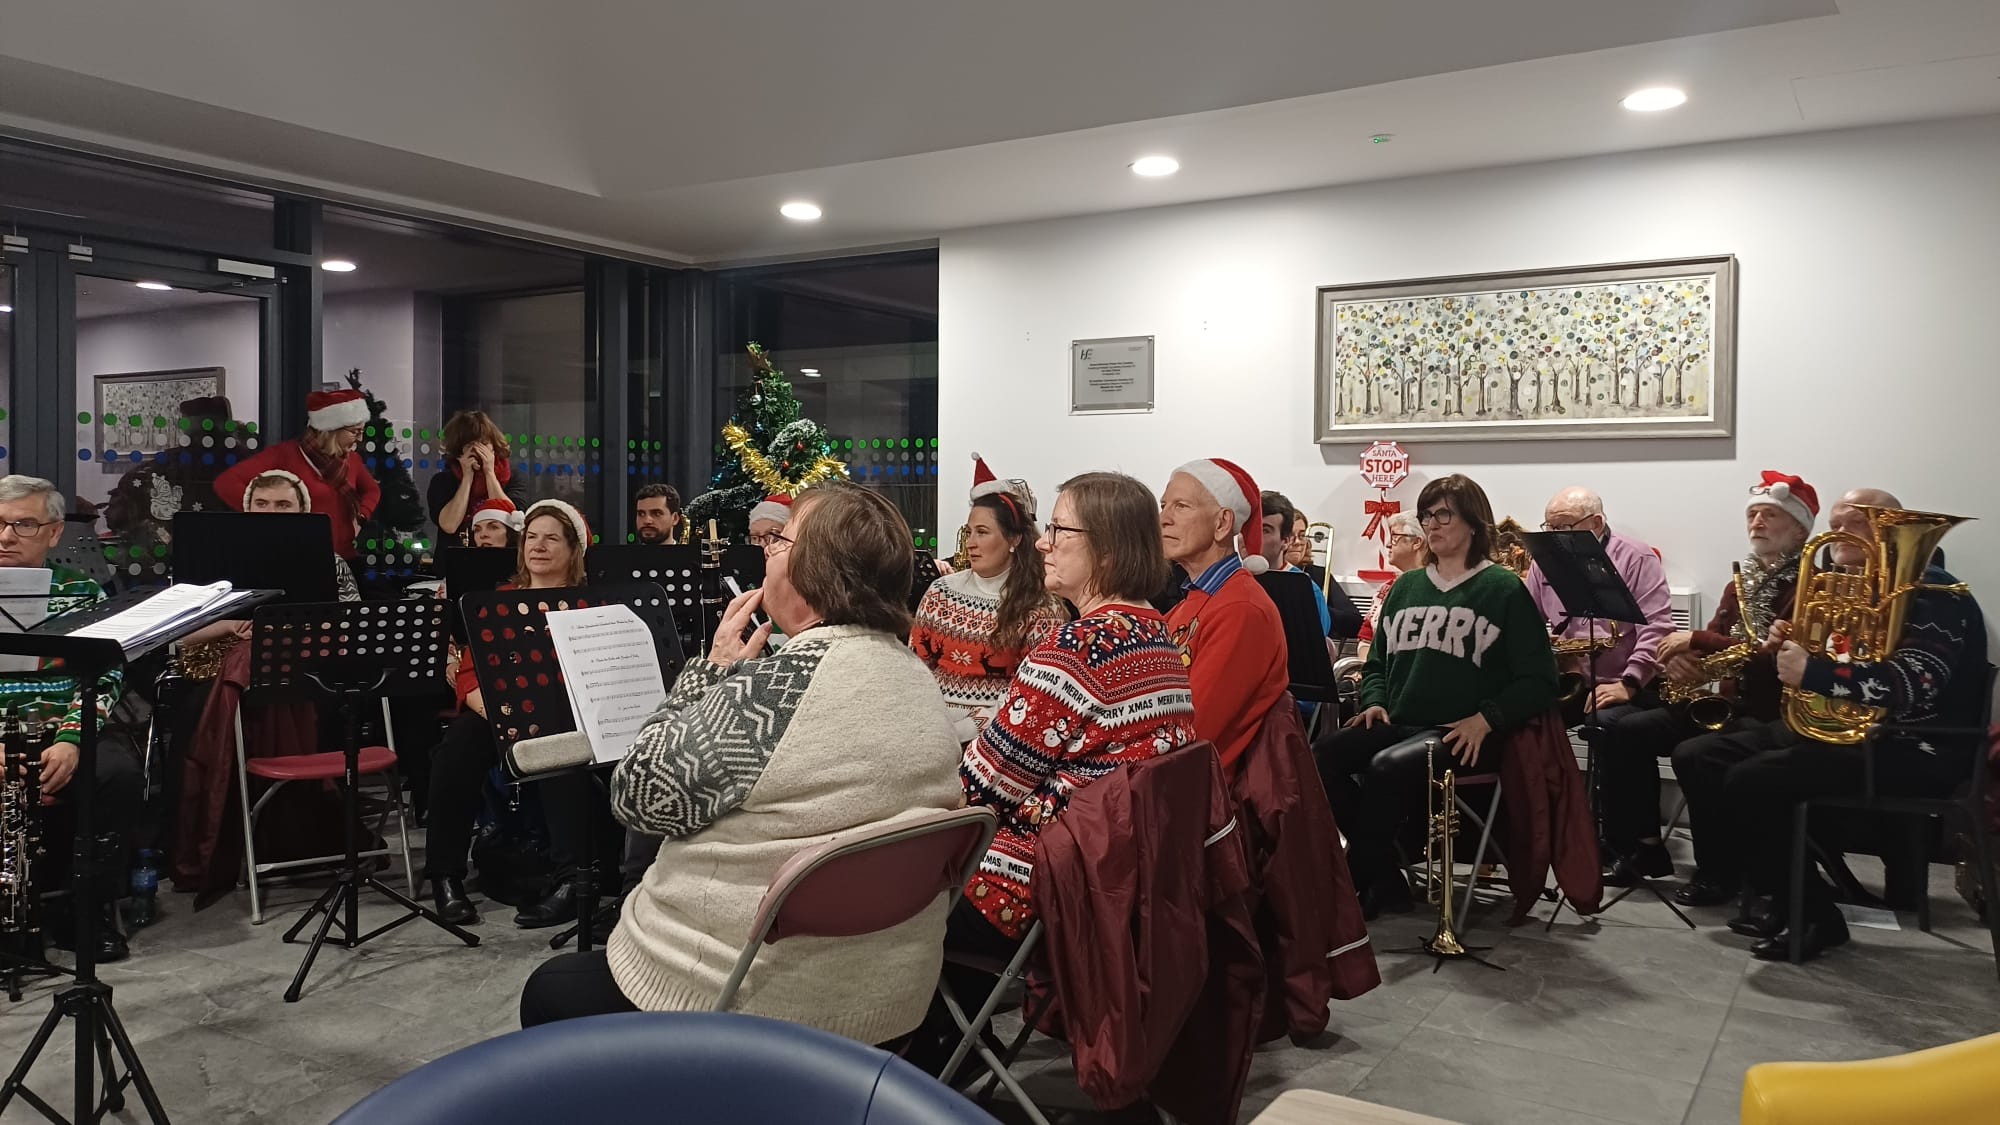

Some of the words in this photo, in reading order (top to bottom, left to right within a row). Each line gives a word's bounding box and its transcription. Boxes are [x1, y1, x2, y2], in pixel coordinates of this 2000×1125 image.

[1372, 449, 1397, 457] SANTA
[1365, 459, 1403, 473] STOP
[1372, 474, 1395, 482] HERE
[1035, 669, 1060, 686] XMAS
[1062, 680, 1089, 706] MERRY
[1128, 699, 1153, 714] XMAS
[974, 760, 996, 784] XMAS
[998, 780, 1028, 798] MERRY
[984, 854, 1002, 868] MAS
[1008, 862, 1030, 877] MER
